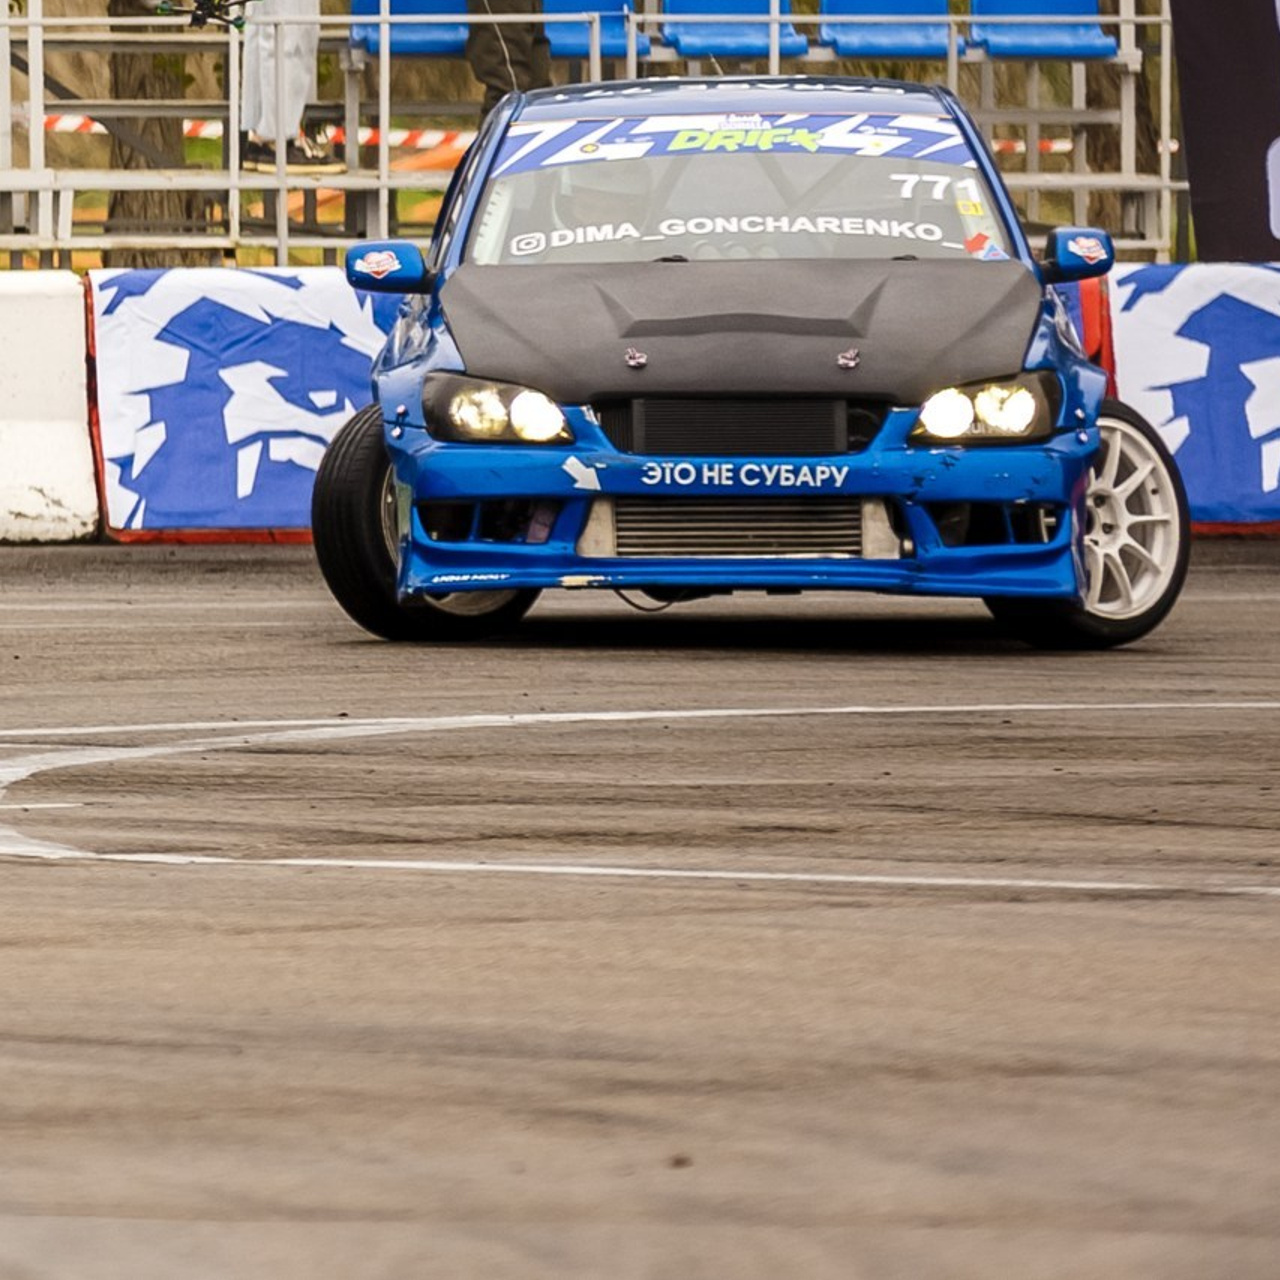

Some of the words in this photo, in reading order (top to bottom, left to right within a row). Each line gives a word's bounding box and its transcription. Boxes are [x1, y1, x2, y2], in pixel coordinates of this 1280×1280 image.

[641, 462, 697, 485] ЭТО
[702, 463, 735, 486] НЕ
[739, 463, 850, 488] СУБАРУ
